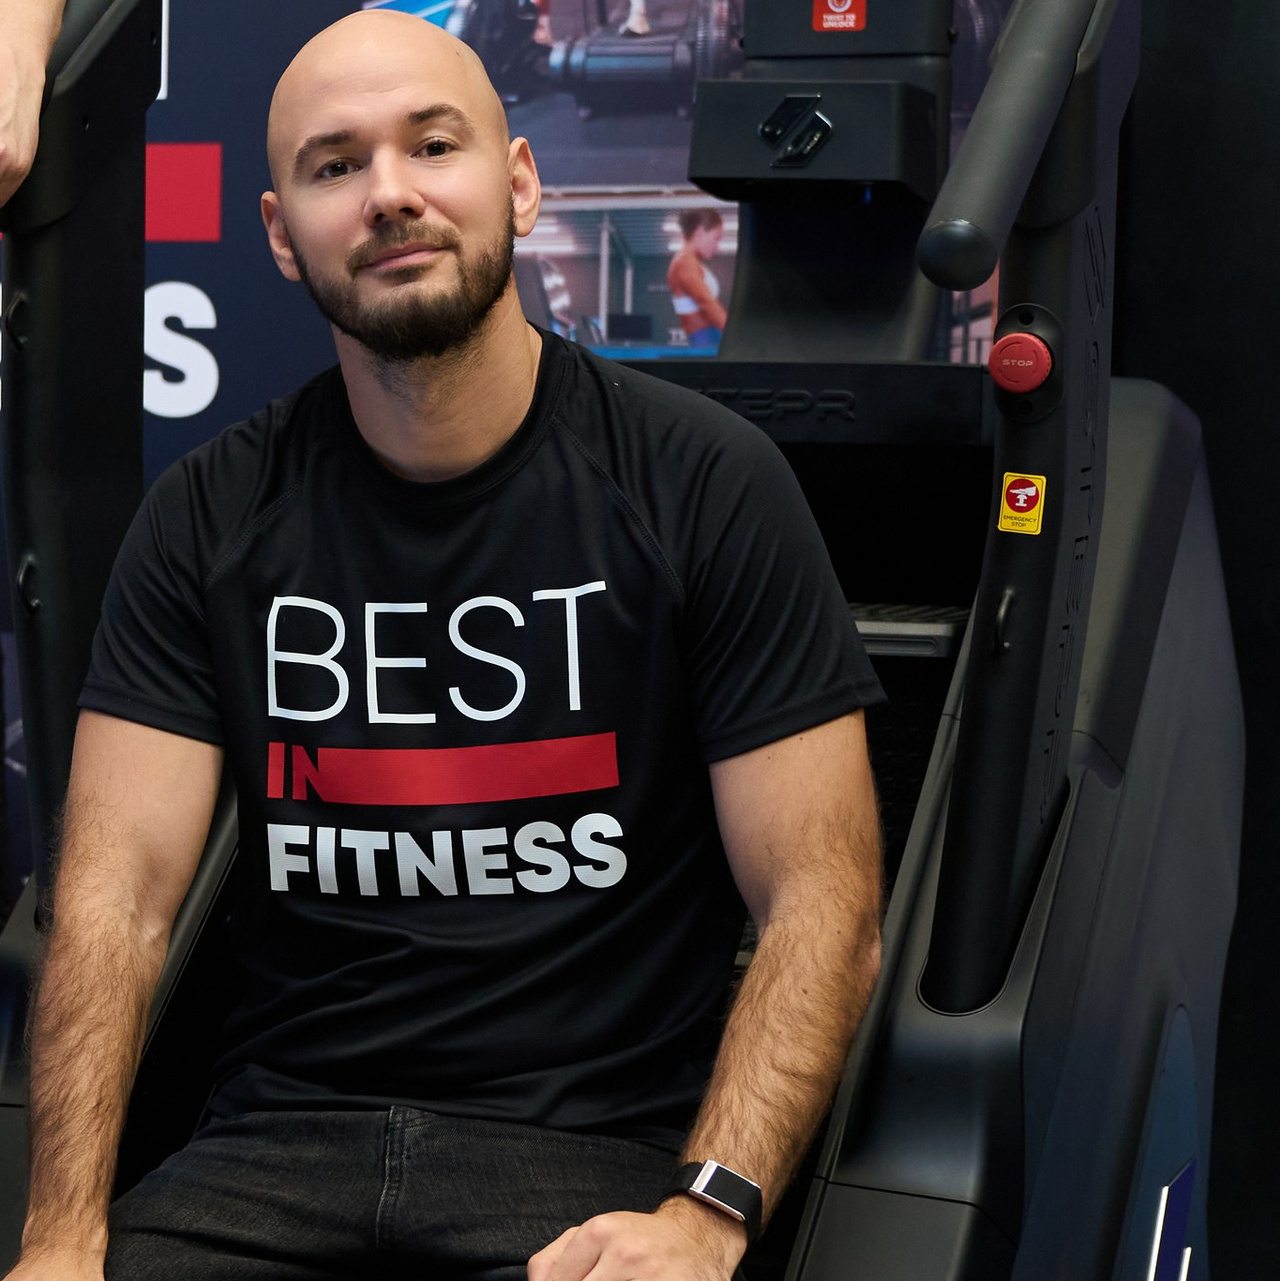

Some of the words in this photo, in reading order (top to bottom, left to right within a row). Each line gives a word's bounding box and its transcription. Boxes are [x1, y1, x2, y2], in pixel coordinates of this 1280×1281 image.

[1002, 359, 1034, 367] STOP
[1003, 514, 1037, 523] EMERGENCY
[266, 580, 607, 724] BEST
[267, 741, 326, 802] IN
[267, 813, 628, 897] FITNESS
